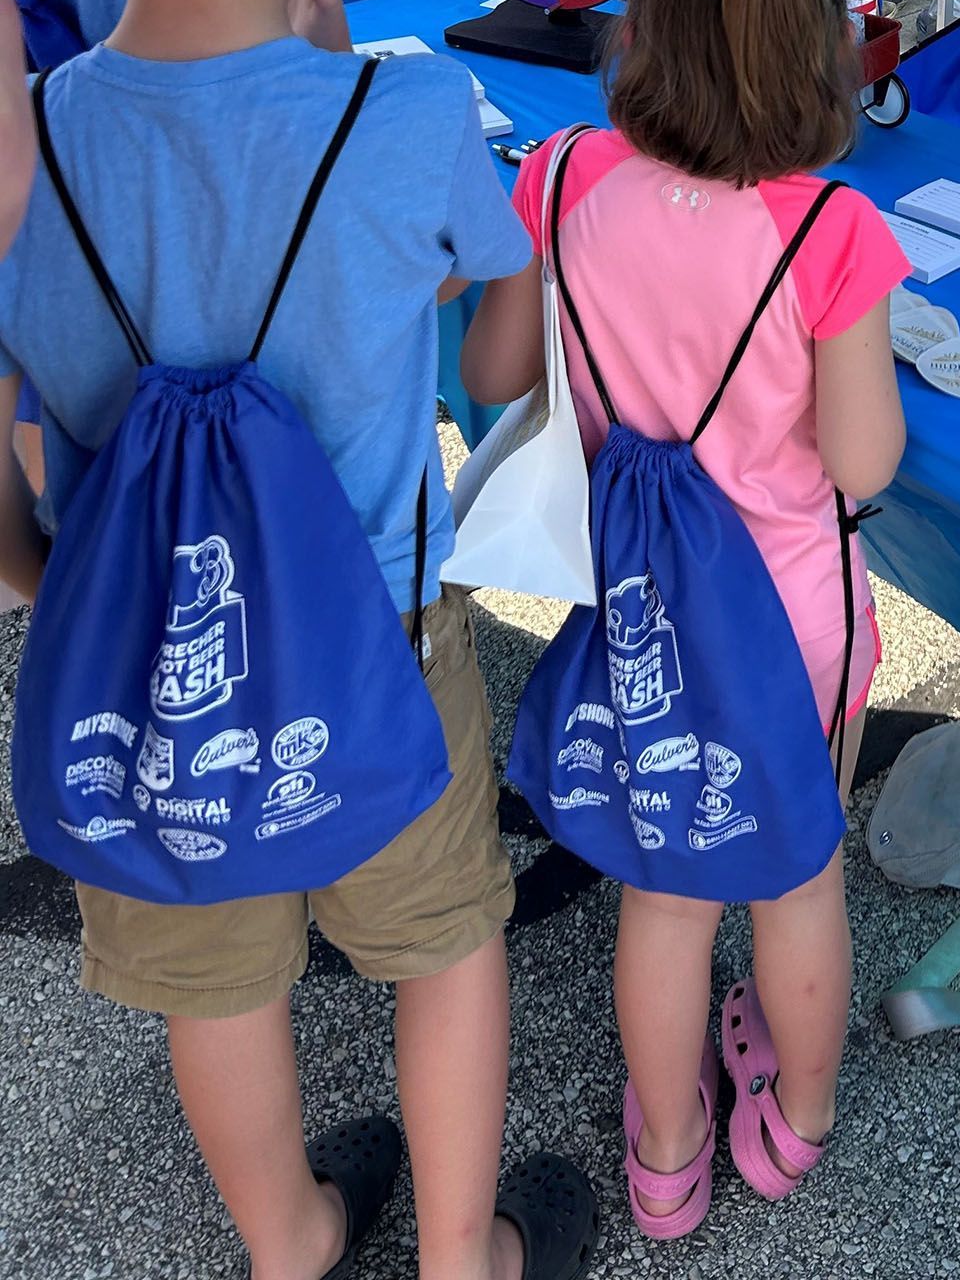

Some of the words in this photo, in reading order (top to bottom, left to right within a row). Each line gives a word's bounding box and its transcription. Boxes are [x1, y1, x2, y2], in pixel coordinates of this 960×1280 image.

[160, 658, 187, 675] OT
[189, 637, 226, 671] BEER
[161, 620, 226, 659] RECHER
[634, 656, 661, 685] BEER
[193, 729, 259, 774] Culver's
[638, 736, 698, 772] Culver's
